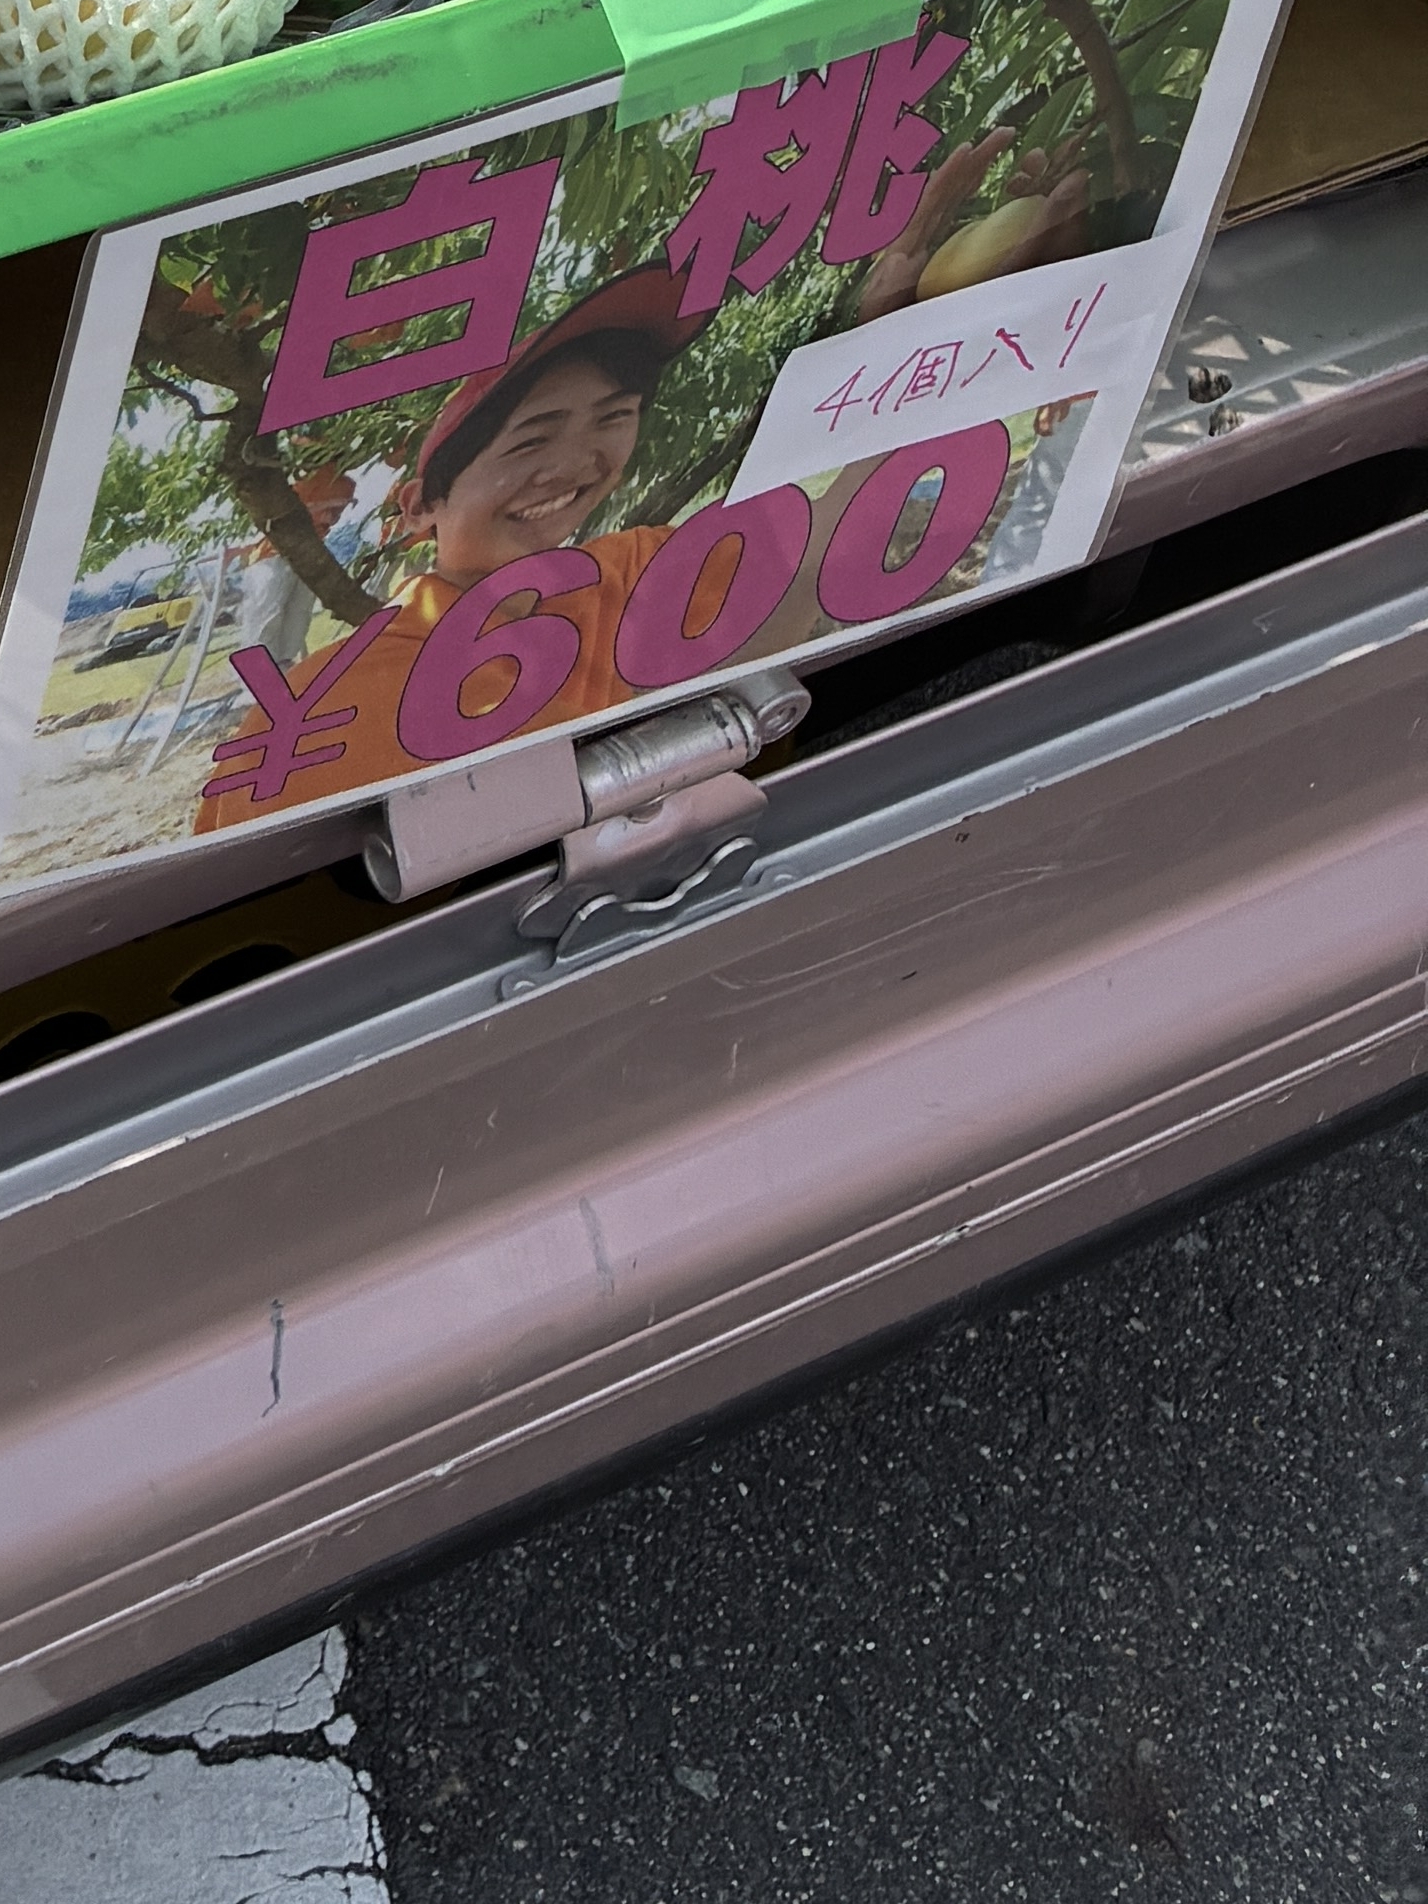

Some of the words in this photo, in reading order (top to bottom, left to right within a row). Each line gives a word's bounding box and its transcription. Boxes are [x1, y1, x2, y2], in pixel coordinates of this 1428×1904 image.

[256, 9, 970, 435] 白桃
[813, 282, 1107, 432] 4個入り
[203, 419, 1011, 803] ¥600
